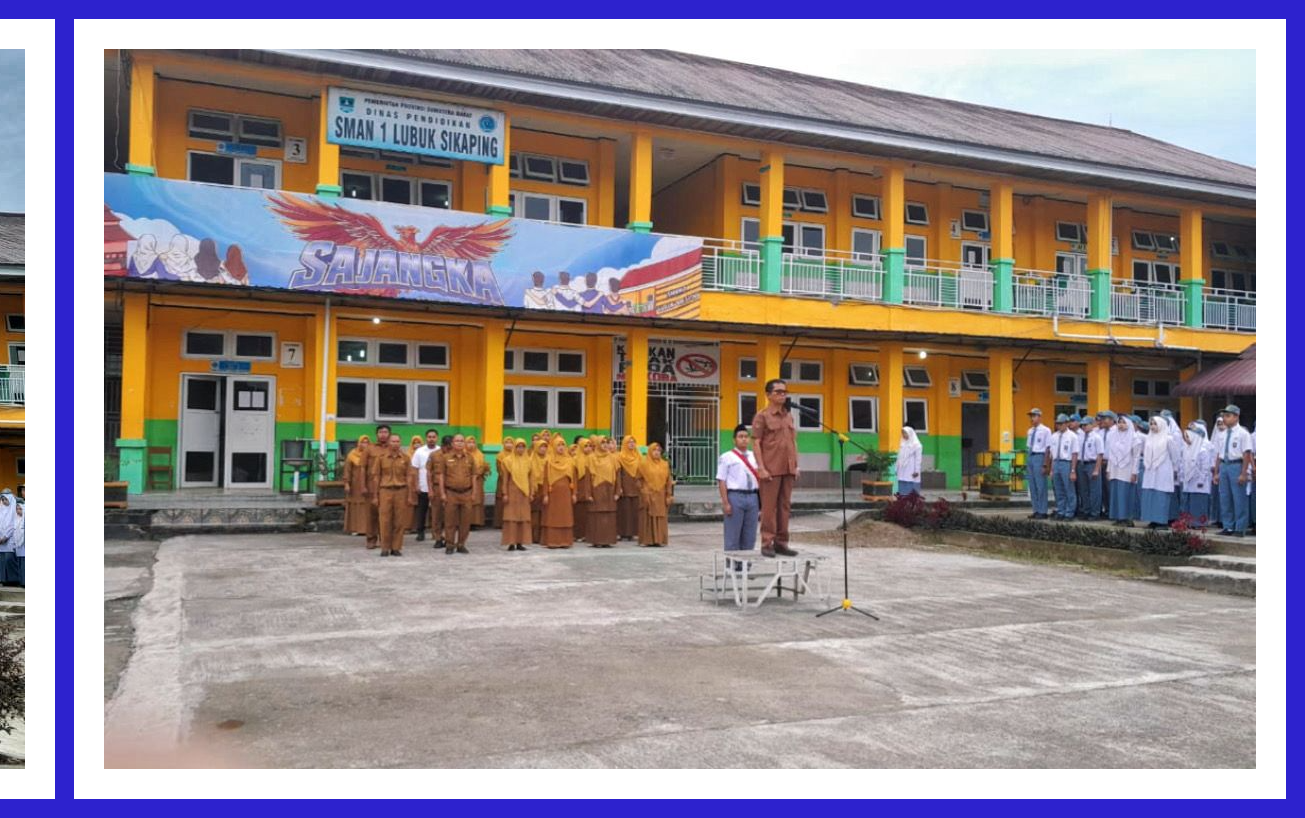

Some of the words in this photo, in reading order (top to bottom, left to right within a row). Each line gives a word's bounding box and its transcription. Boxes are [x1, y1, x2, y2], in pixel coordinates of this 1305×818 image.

[335, 115, 374, 141] SMAN
[380, 122, 386, 142] 1
[393, 123, 436, 149] LUBUK
[440, 130, 498, 158] SIKAPING
[366, 107, 399, 119] DINAS
[406, 113, 471, 129] PENDIDIKAN
[288, 240, 505, 306] SAJANGKA
